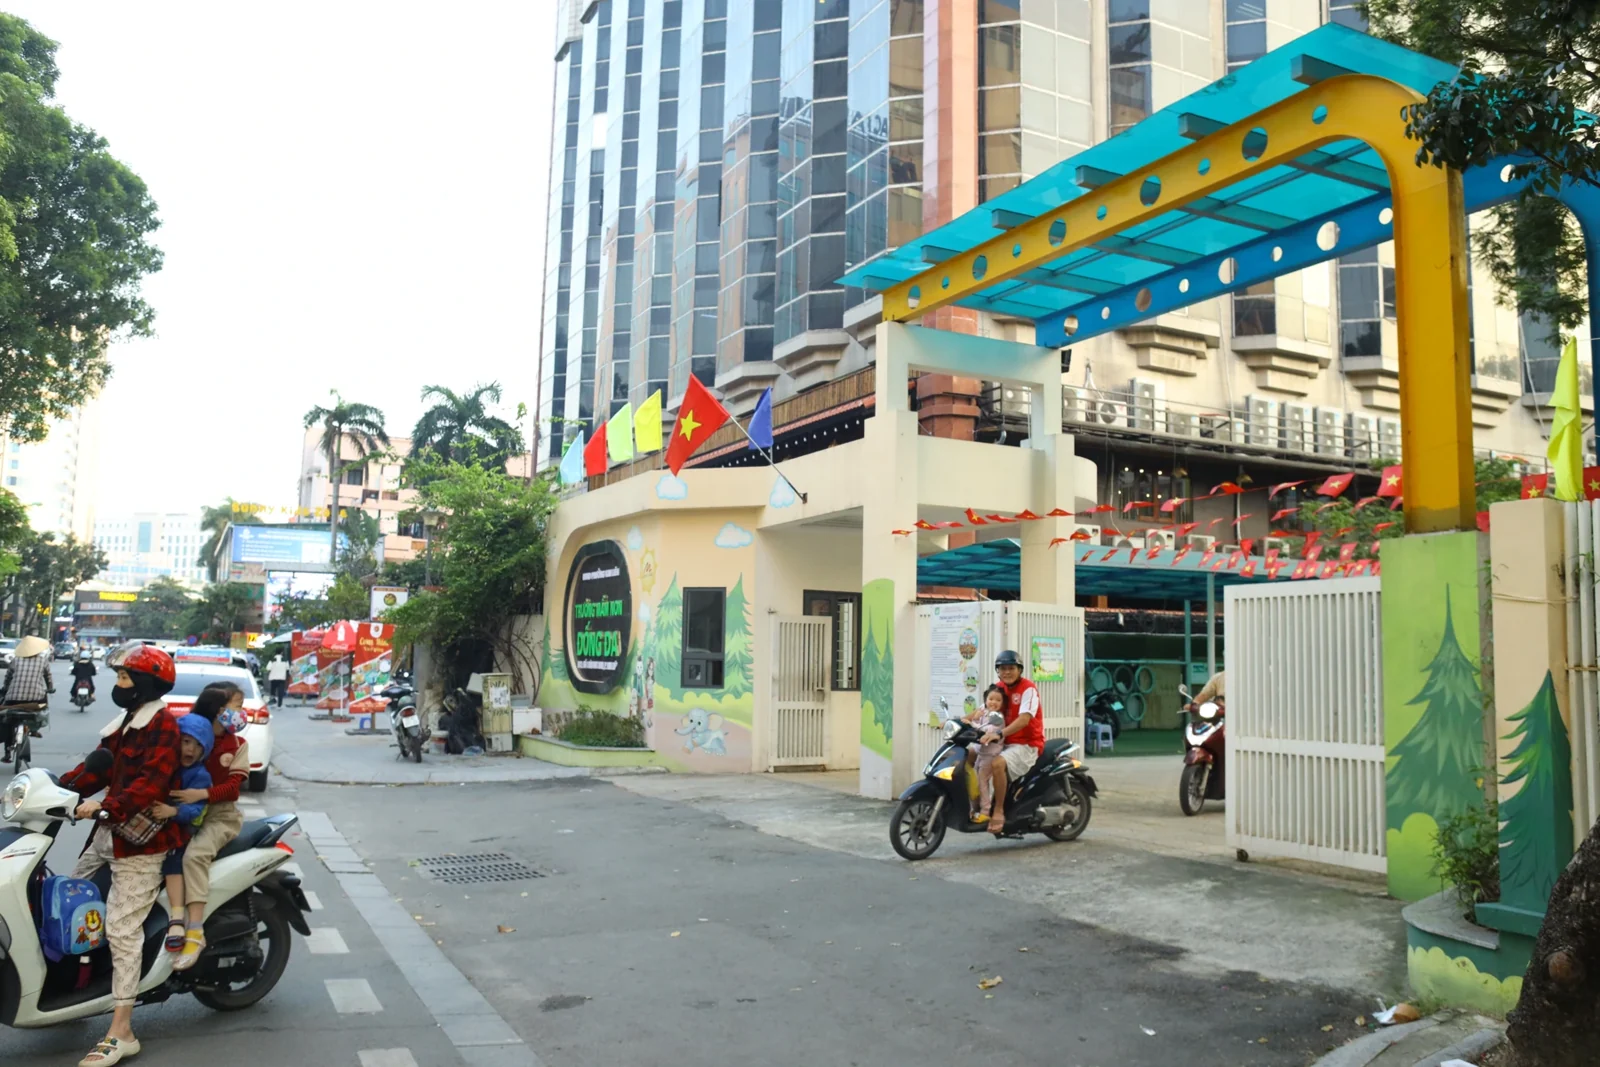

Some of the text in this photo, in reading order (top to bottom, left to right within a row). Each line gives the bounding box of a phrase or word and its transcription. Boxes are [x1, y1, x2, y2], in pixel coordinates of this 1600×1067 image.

[314, 506, 348, 519] Zoe
[577, 620, 622, 656] ĐỐNG ĐA
